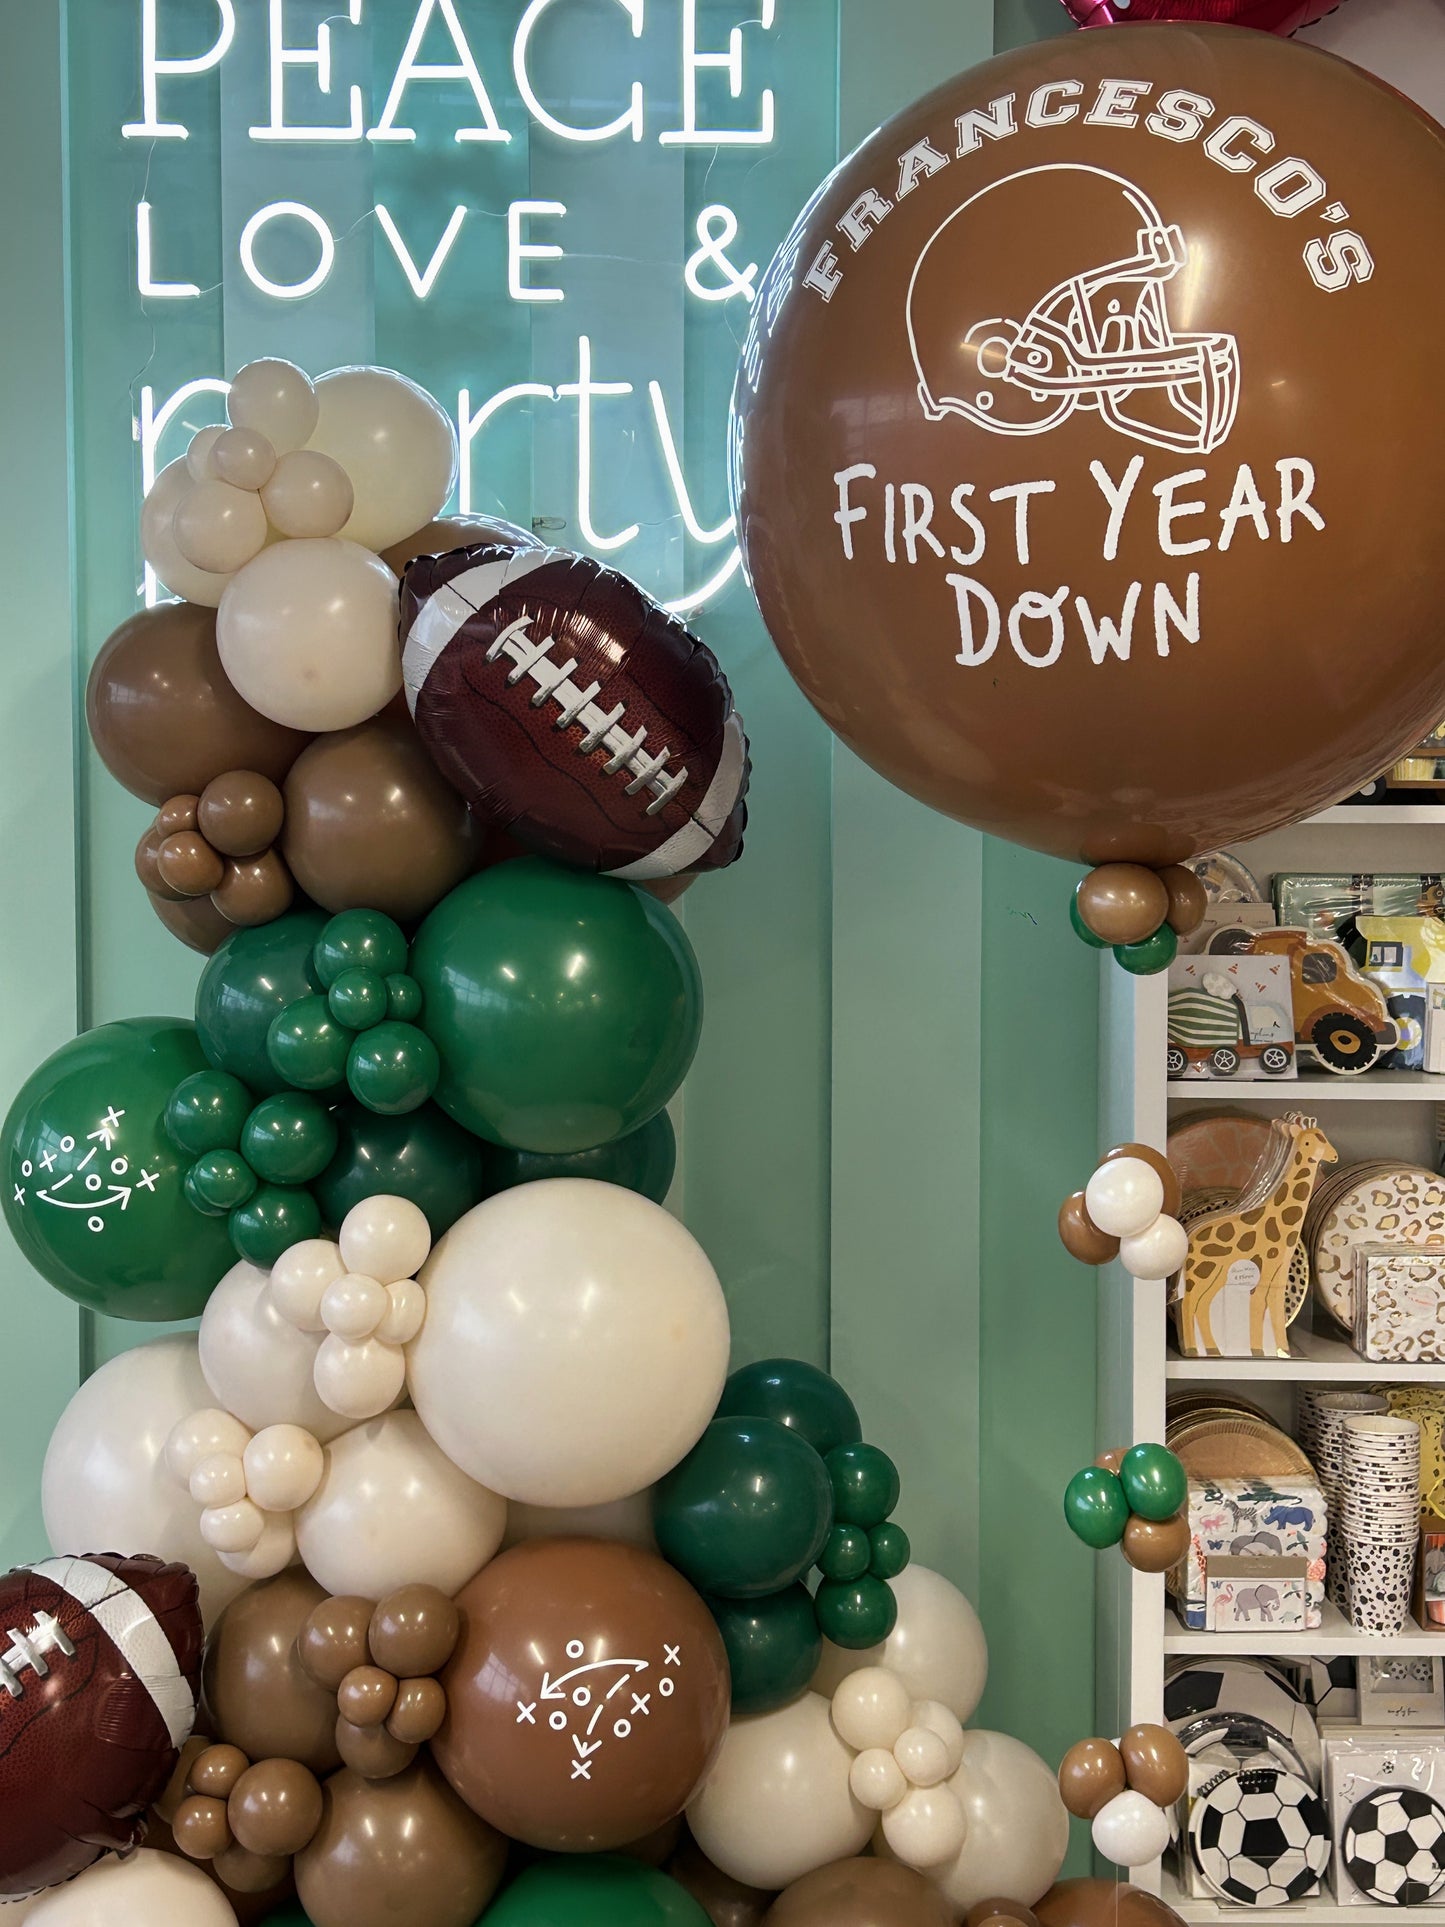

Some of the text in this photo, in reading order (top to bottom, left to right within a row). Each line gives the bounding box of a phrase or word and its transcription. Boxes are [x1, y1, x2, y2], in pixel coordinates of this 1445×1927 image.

[121, 0, 774, 146] PEACE
[802, 78, 1375, 303] FRANCESCO'S
[136, 200, 758, 303] LOVE &
[833, 454, 1326, 566] FIRST YEAR
[945, 572, 1202, 669] DOWN
